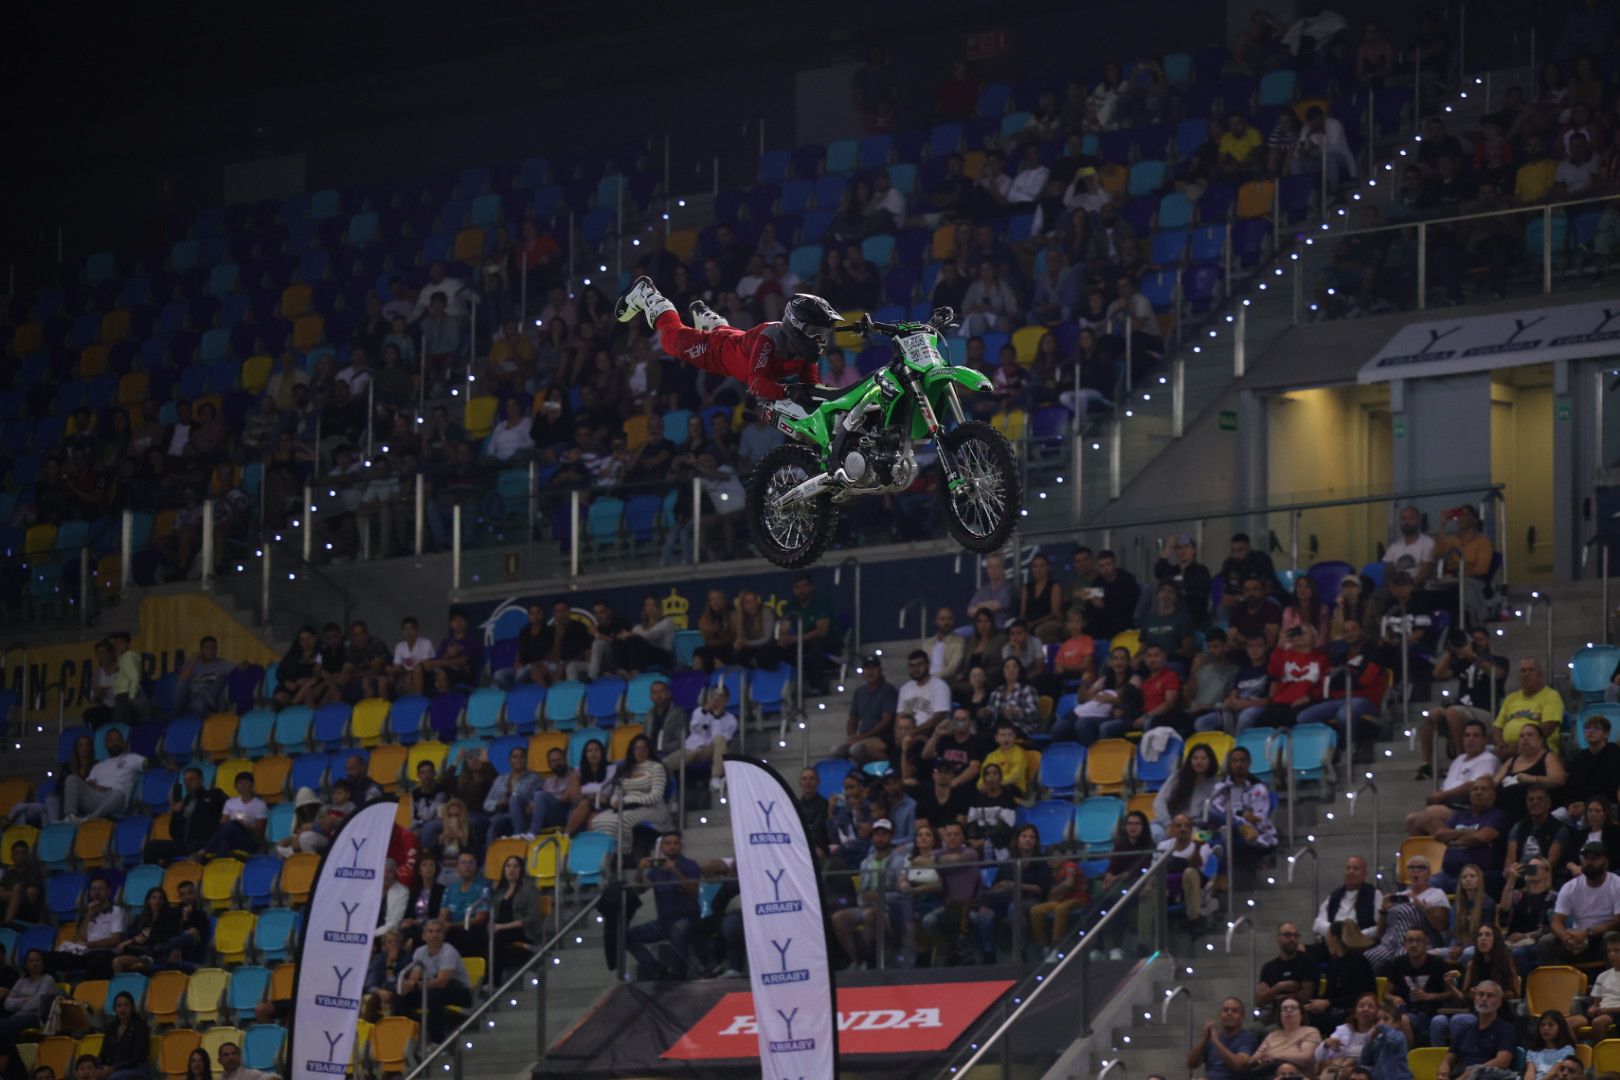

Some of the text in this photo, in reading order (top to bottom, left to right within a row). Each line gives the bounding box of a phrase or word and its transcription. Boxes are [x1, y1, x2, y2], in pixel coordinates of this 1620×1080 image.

[336, 868, 375, 879] YBARRA
[326, 932, 367, 944] YBARRA
[317, 996, 358, 1009] YBARRA
[718, 1008, 943, 1035] HDA
